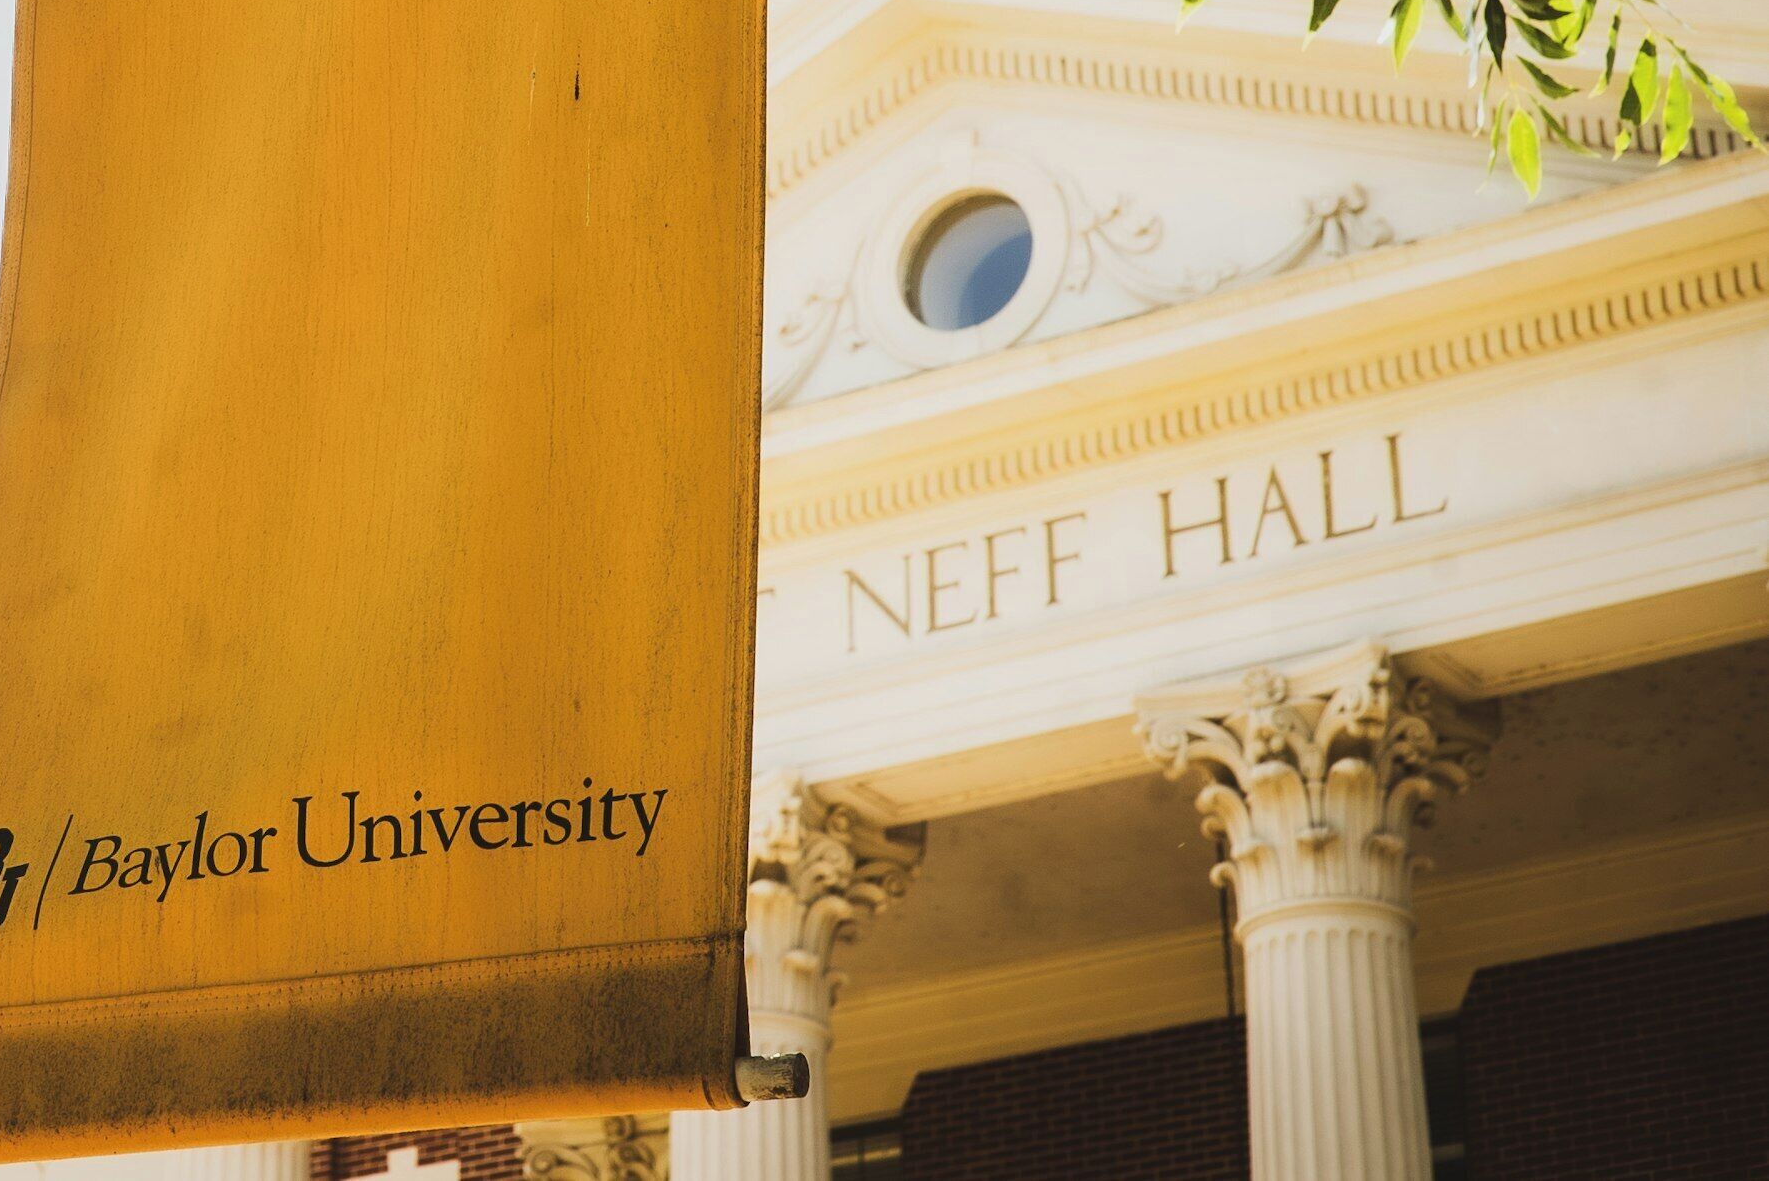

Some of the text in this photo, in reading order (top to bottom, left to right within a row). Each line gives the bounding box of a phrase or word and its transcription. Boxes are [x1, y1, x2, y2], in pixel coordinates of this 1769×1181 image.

[843, 431, 1449, 654] NEFF HALL
[67, 810, 277, 903] Baylor
[292, 777, 669, 868] University
